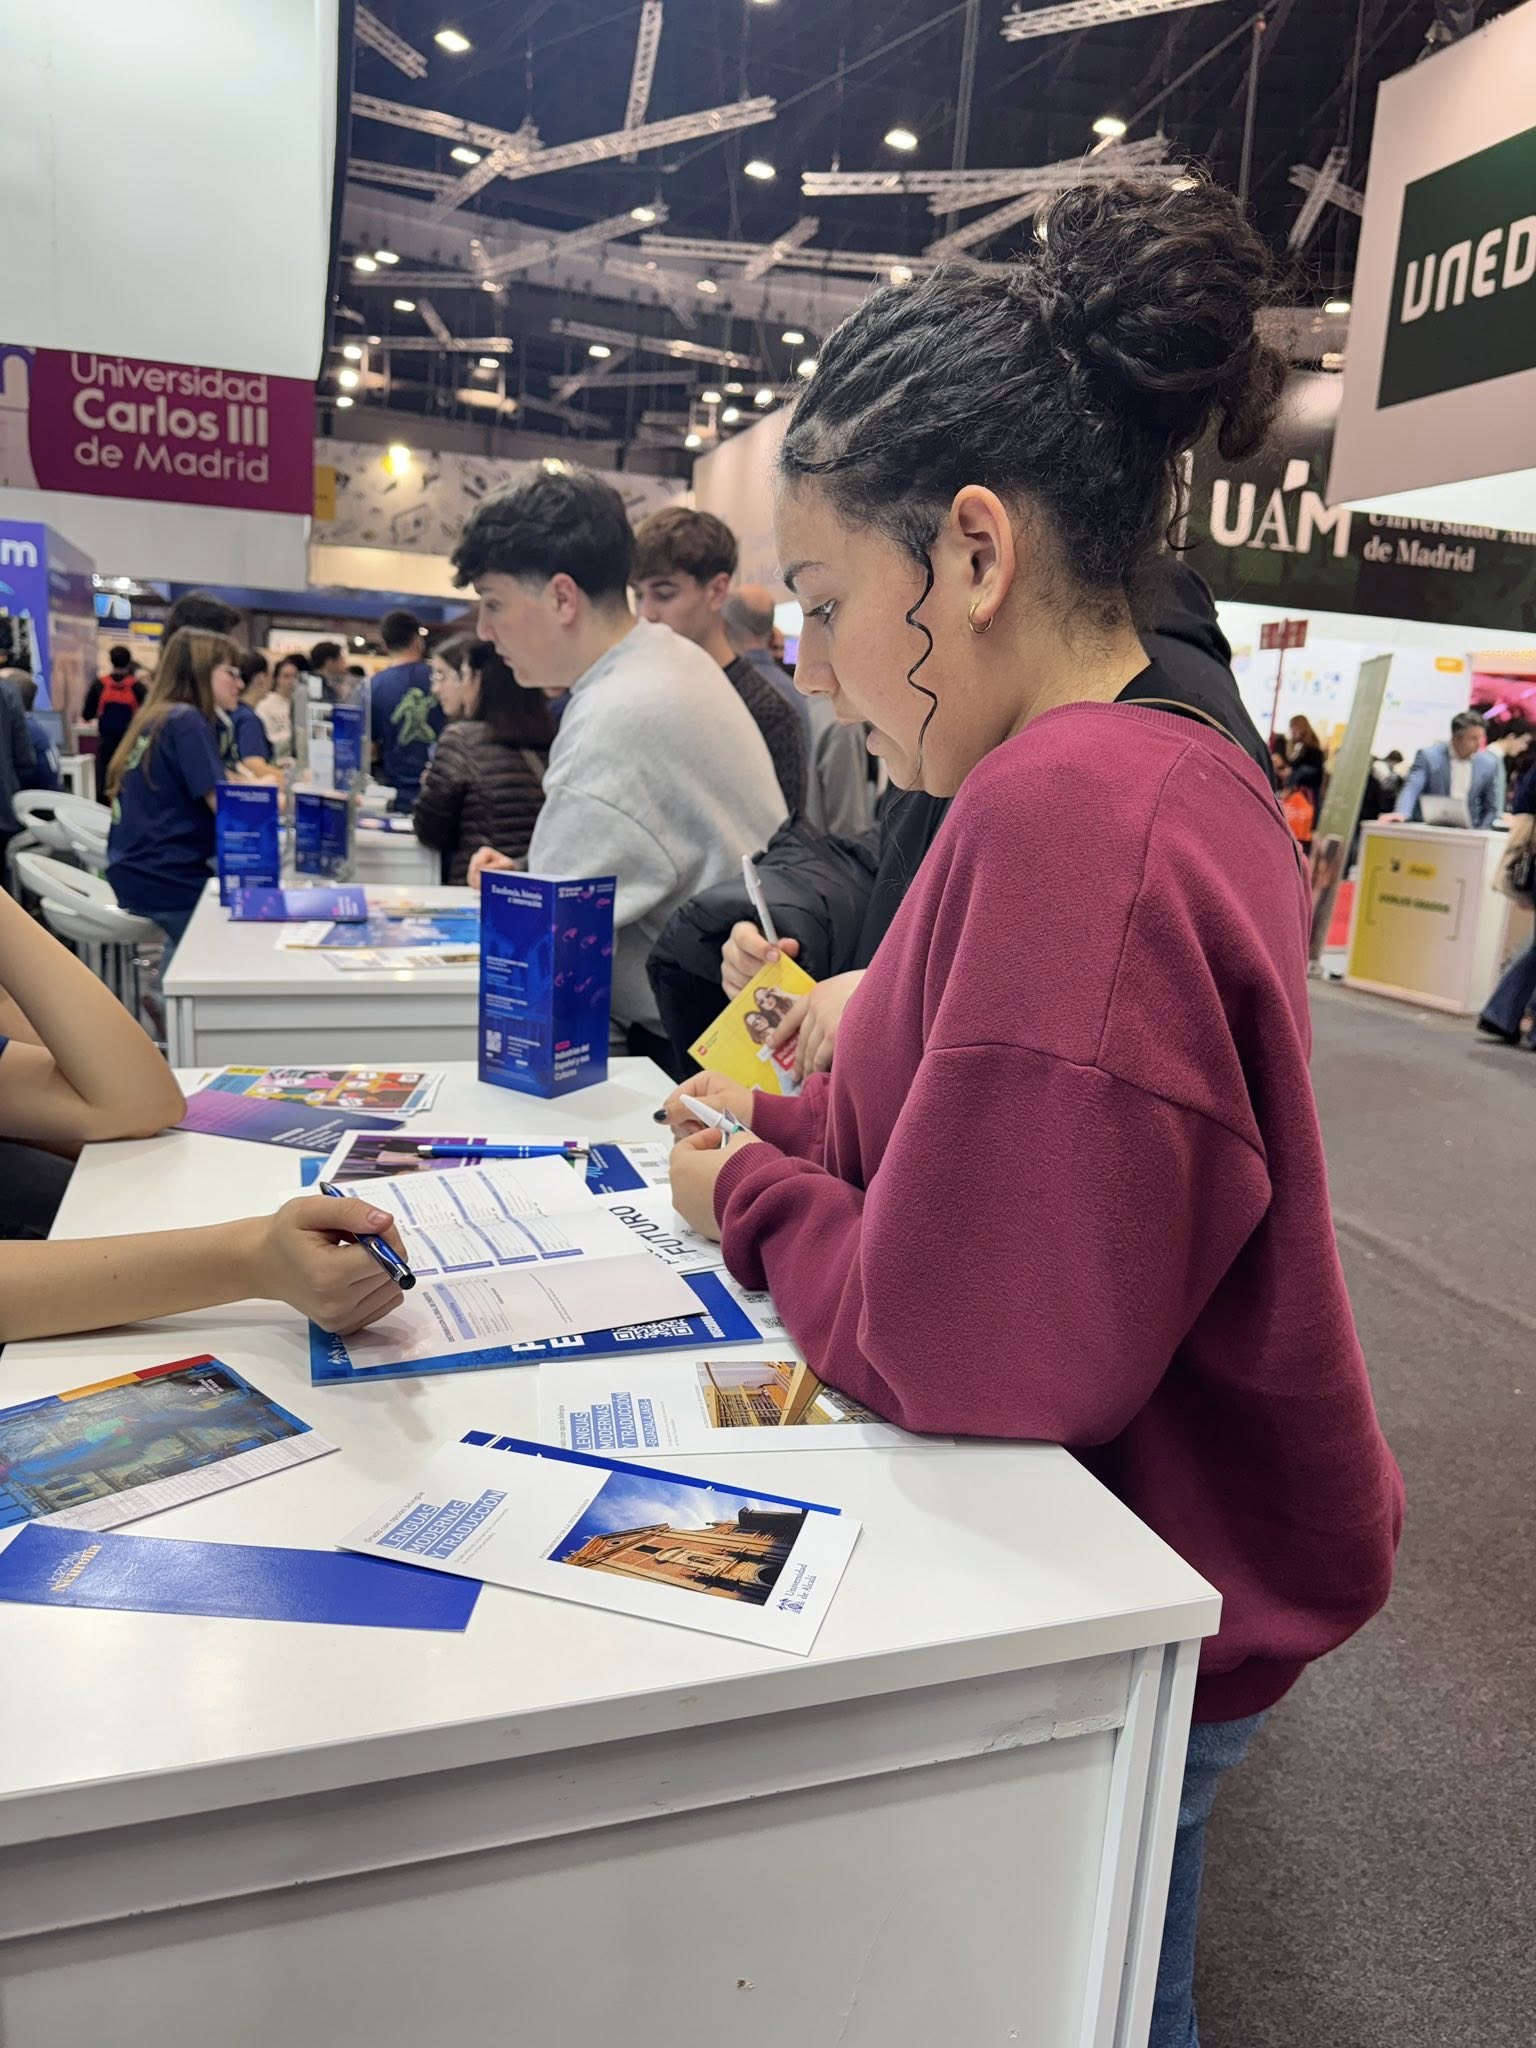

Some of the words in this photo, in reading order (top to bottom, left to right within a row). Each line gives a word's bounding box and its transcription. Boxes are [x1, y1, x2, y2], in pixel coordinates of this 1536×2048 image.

[1400, 215, 1536, 324] UNED
[70, 351, 268, 404] Universidad
[73, 388, 219, 441] Carlos
[227, 404, 269, 447] III
[74, 436, 124, 468] de
[134, 442, 269, 484] Madrid
[1363, 535, 1393, 563] de
[1396, 538, 1476, 573] Madrid
[608, 1205, 698, 1256] FUTURO
[575, 1412, 591, 1450] LENGUAS
[596, 1404, 617, 1449] MODERNAS
[613, 1392, 635, 1442] TRADUCCIÓN
[381, 1504, 438, 1548] LENGUAS
[406, 1501, 469, 1553] MODERNAS
[429, 1549, 445, 1558] Y
[440, 1490, 505, 1551] TRADUCCIÓN
[785, 1563, 808, 1596] Universidad
[797, 1592, 809, 1600] de
[801, 1574, 817, 1592] Alcalá
